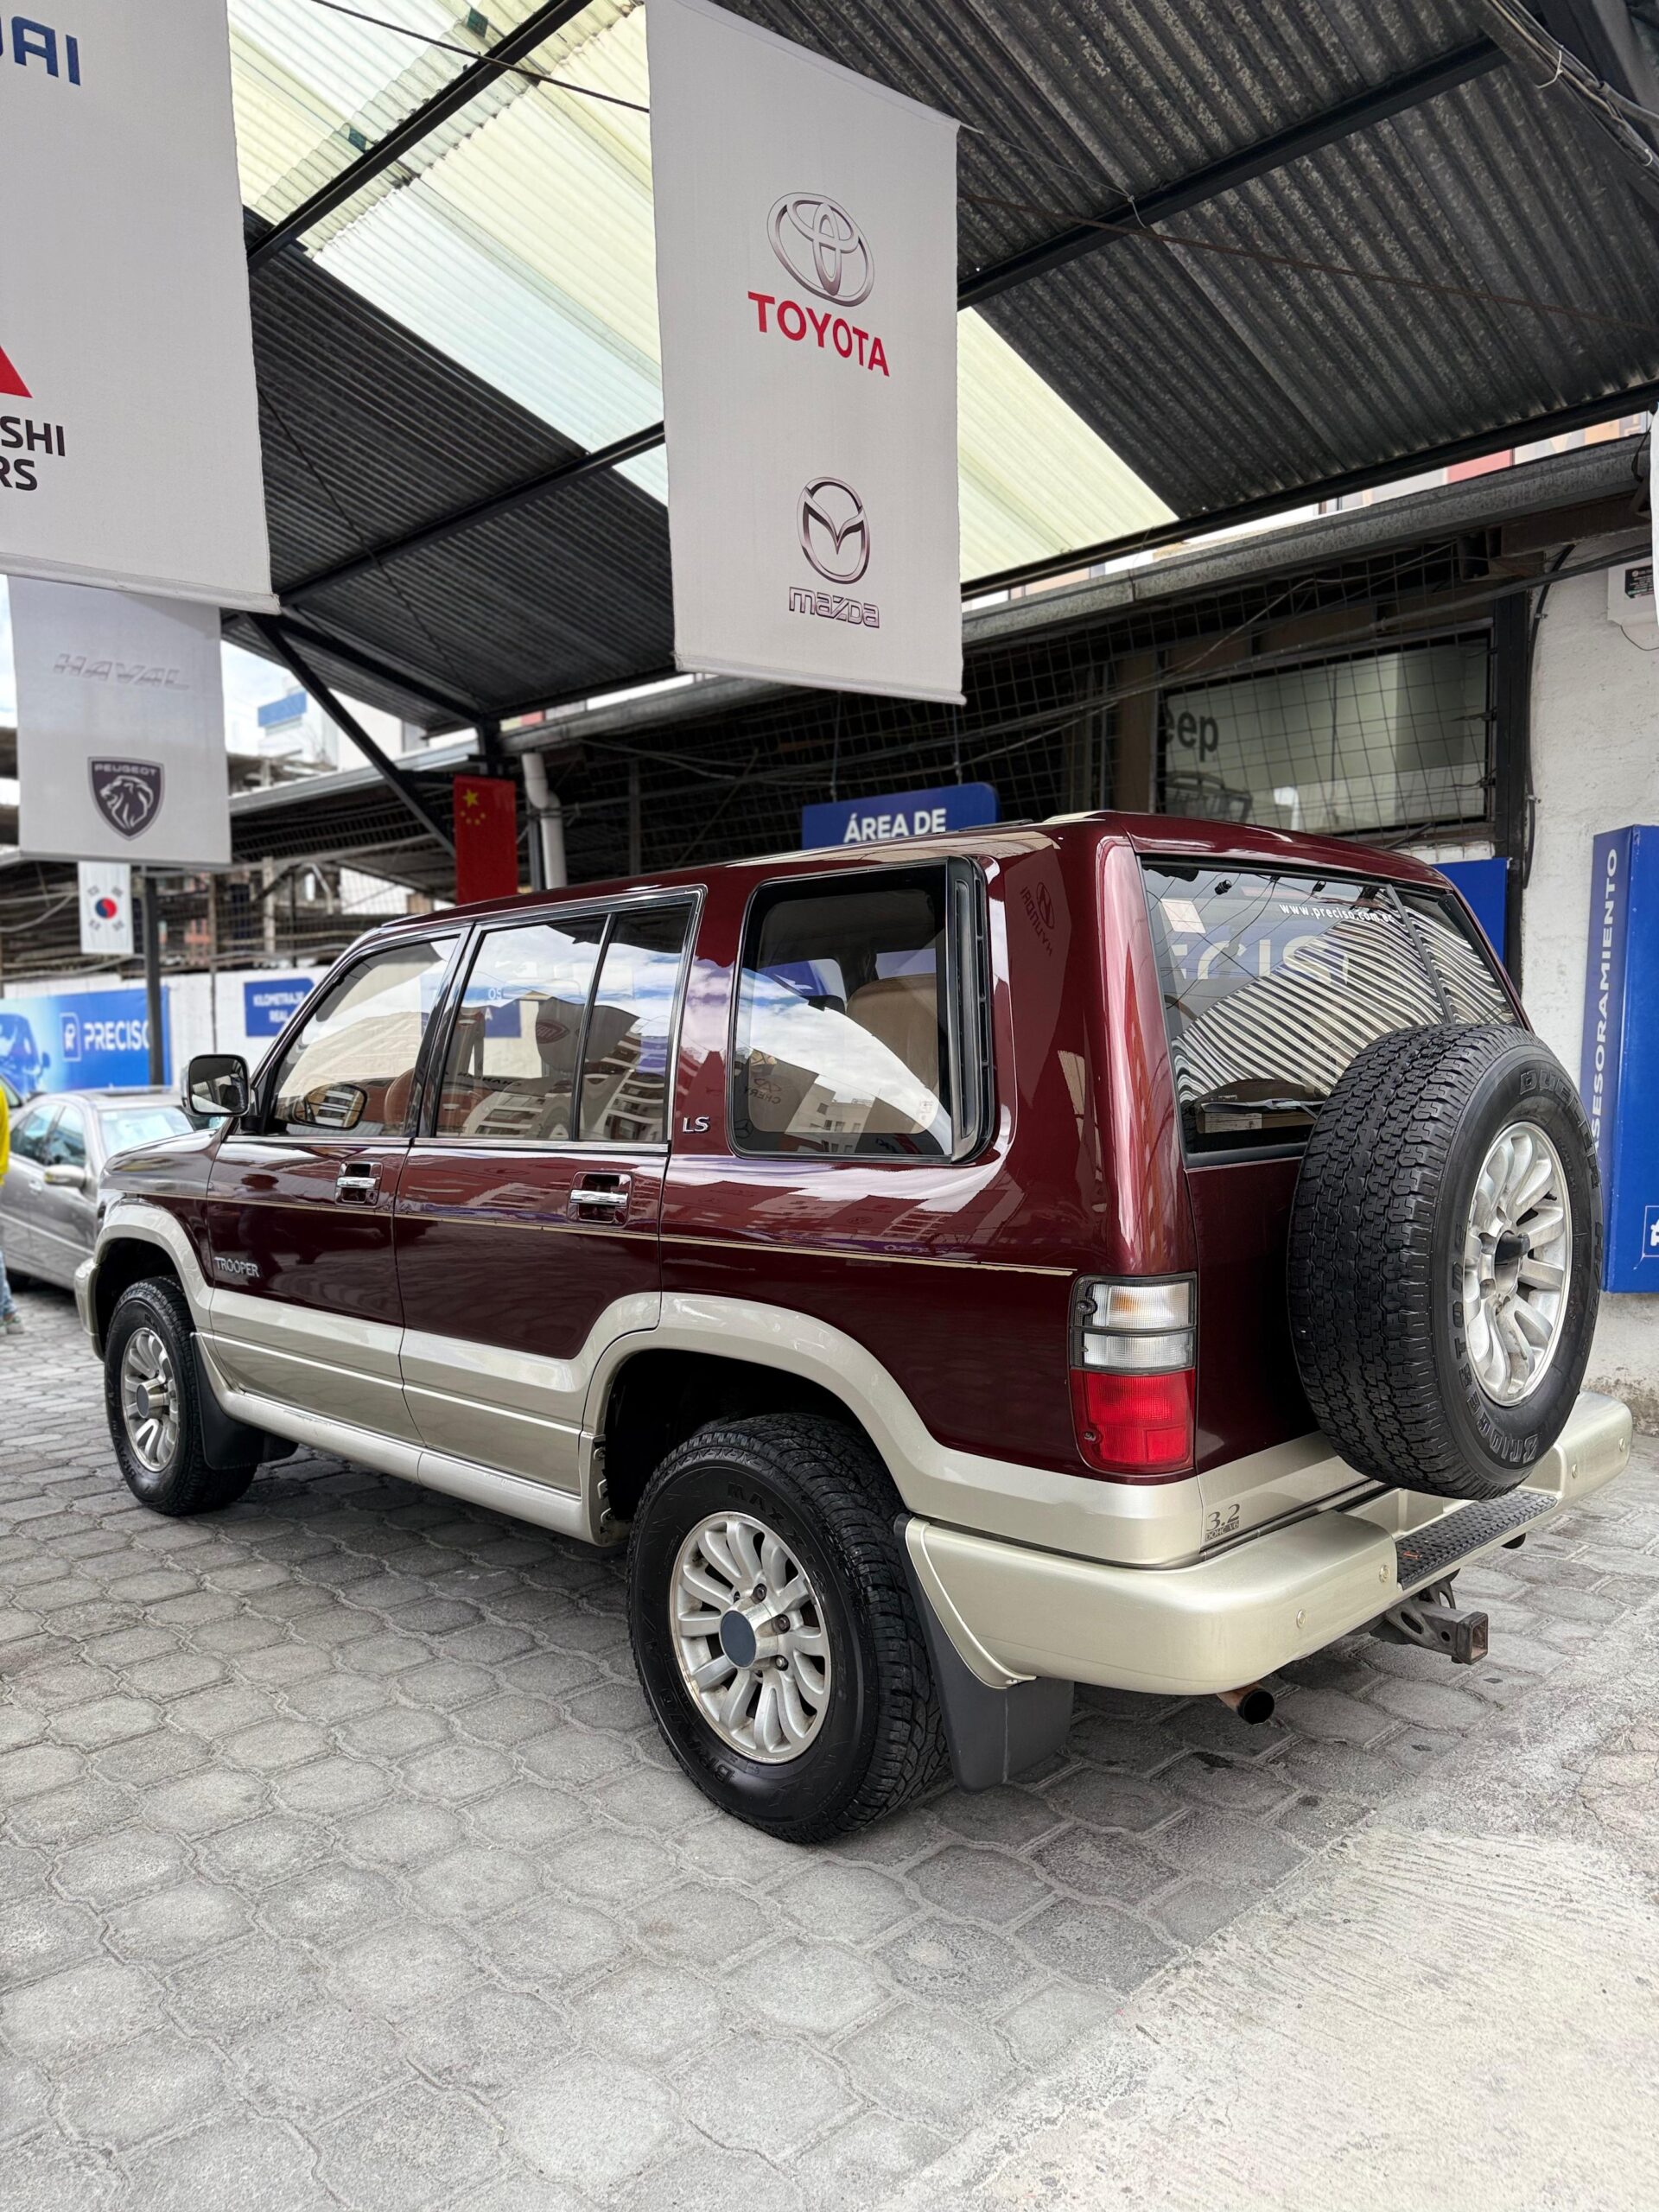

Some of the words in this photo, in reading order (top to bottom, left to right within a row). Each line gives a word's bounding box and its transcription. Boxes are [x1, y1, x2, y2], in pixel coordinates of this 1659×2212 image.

[0, 16, 81, 86] AI
[747, 290, 890, 378] TOYOTA
[53, 652, 190, 691] HAVAL
[94, 763, 158, 776] PEUGEOT
[843, 812, 910, 843] ÁREA
[914, 808, 946, 836] DE
[683, 1116, 710, 1134] LS
[213, 1256, 260, 1278] TROOPER
[1206, 1503, 1240, 1532] 3.2
